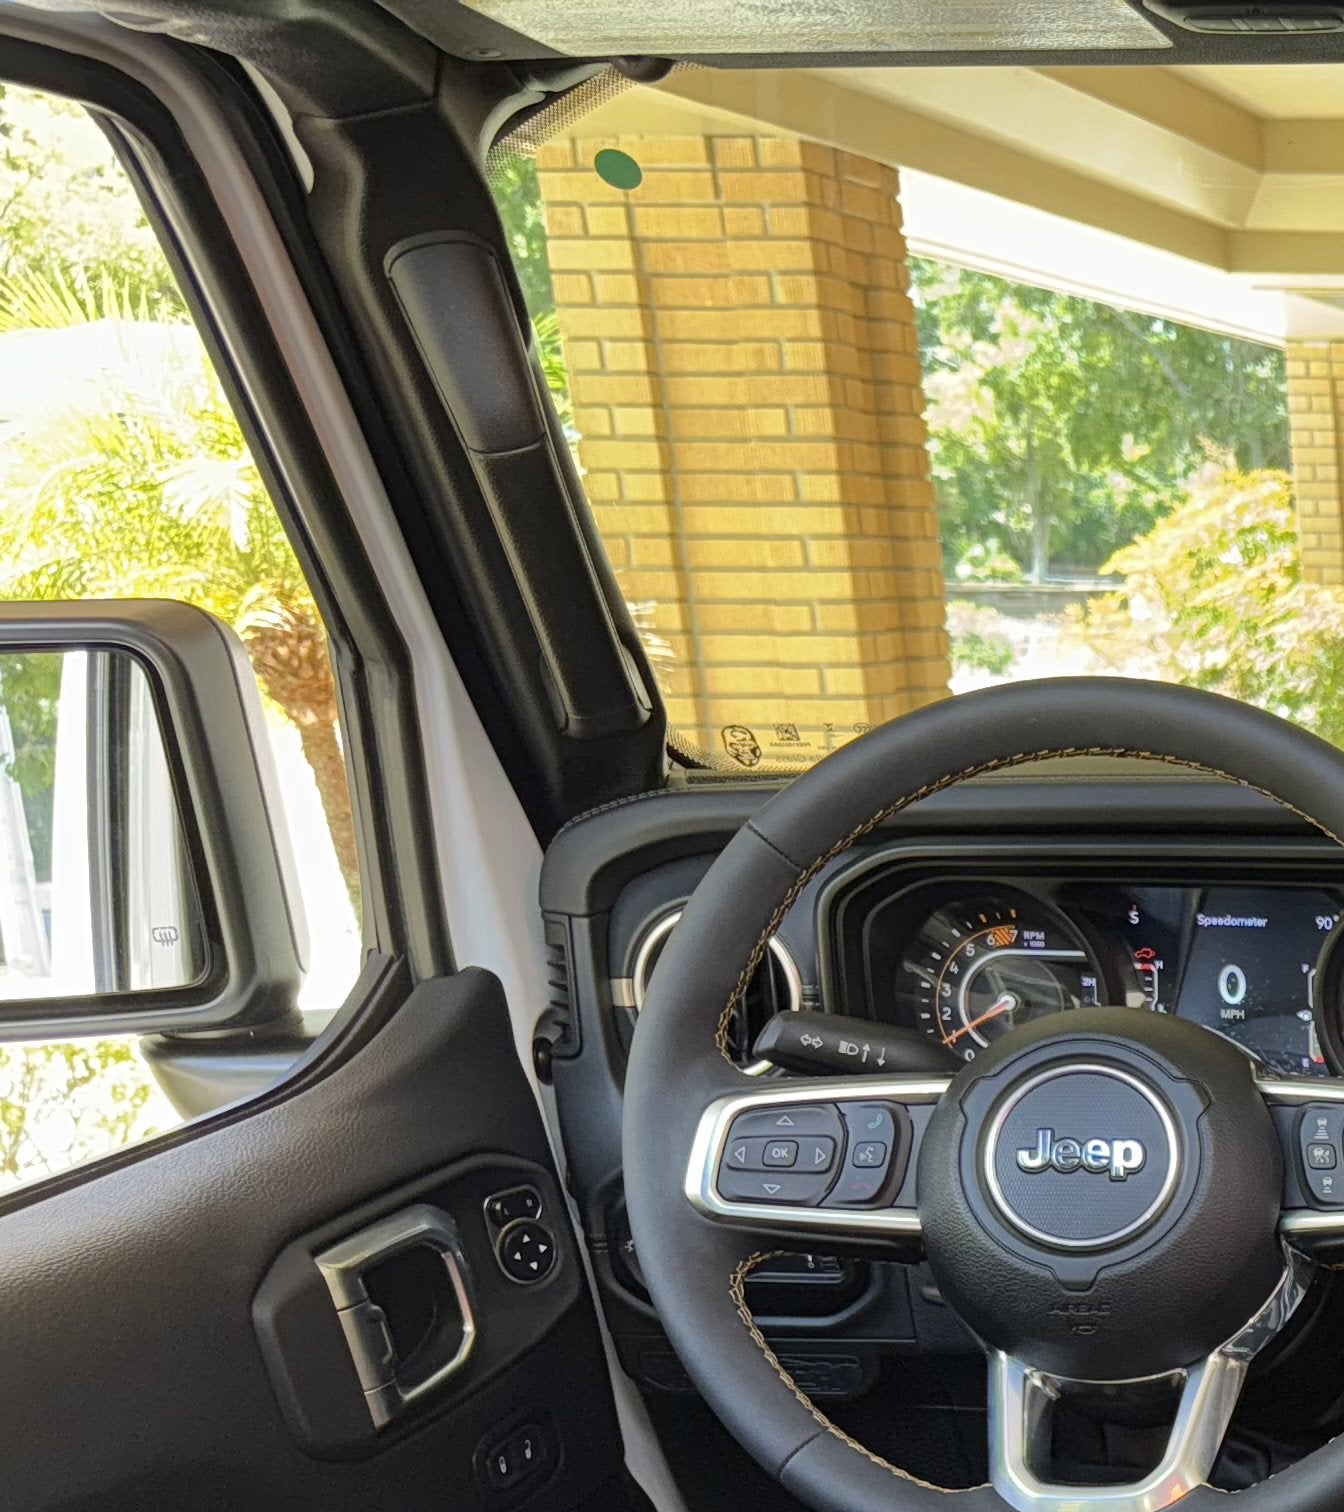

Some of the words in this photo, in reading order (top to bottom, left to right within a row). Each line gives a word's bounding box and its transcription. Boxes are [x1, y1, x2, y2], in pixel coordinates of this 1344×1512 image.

[1196, 913, 1268, 929] Speedometer
[1315, 914, 1340, 931] 90°
[986, 933, 995, 946] 6
[965, 943, 976, 957] 5
[950, 961, 959, 975] 4
[941, 983, 952, 997] 3
[1218, 964, 1247, 1005] 0
[941, 1007, 952, 1021] 2
[1220, 1008, 1245, 1020] MPH
[964, 1049, 976, 1063] 0
[772, 1147, 789, 1160] OK
[1015, 1127, 1146, 1183] Jeep
